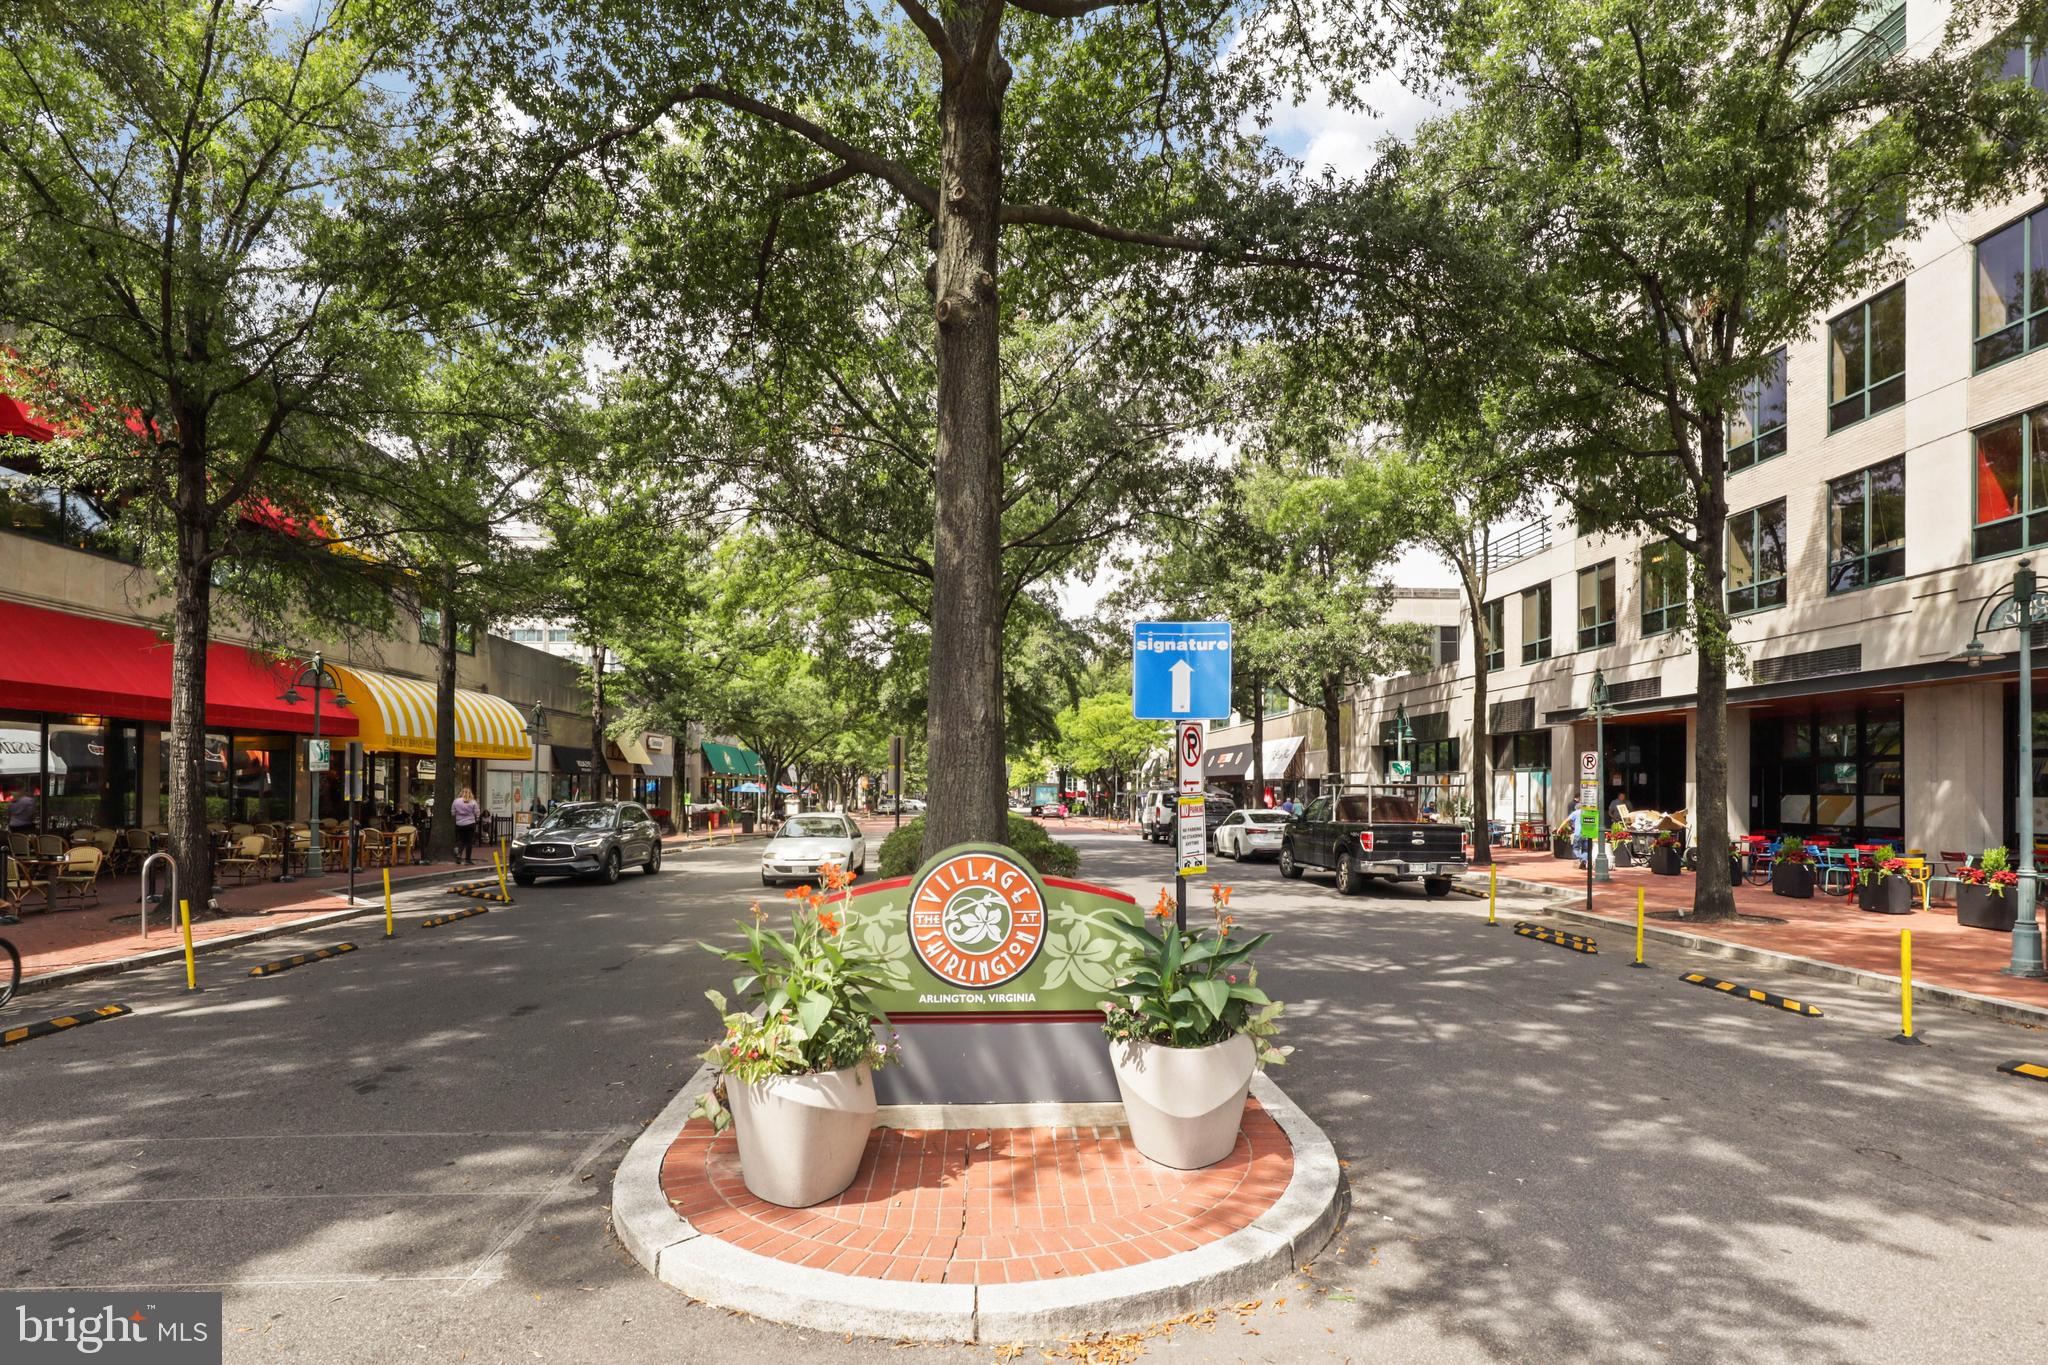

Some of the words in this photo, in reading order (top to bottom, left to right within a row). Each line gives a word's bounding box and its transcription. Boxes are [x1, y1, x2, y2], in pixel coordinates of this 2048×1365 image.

[1136, 637, 1229, 653] signature
[921, 860, 1031, 904] VILLAGE
[917, 914, 941, 924] THE
[1020, 913, 1037, 923] AT
[917, 930, 1036, 981] SHIRLINGTON
[918, 993, 986, 1005] ARLINGTON,
[988, 993, 1036, 1003] VIRGINIA
